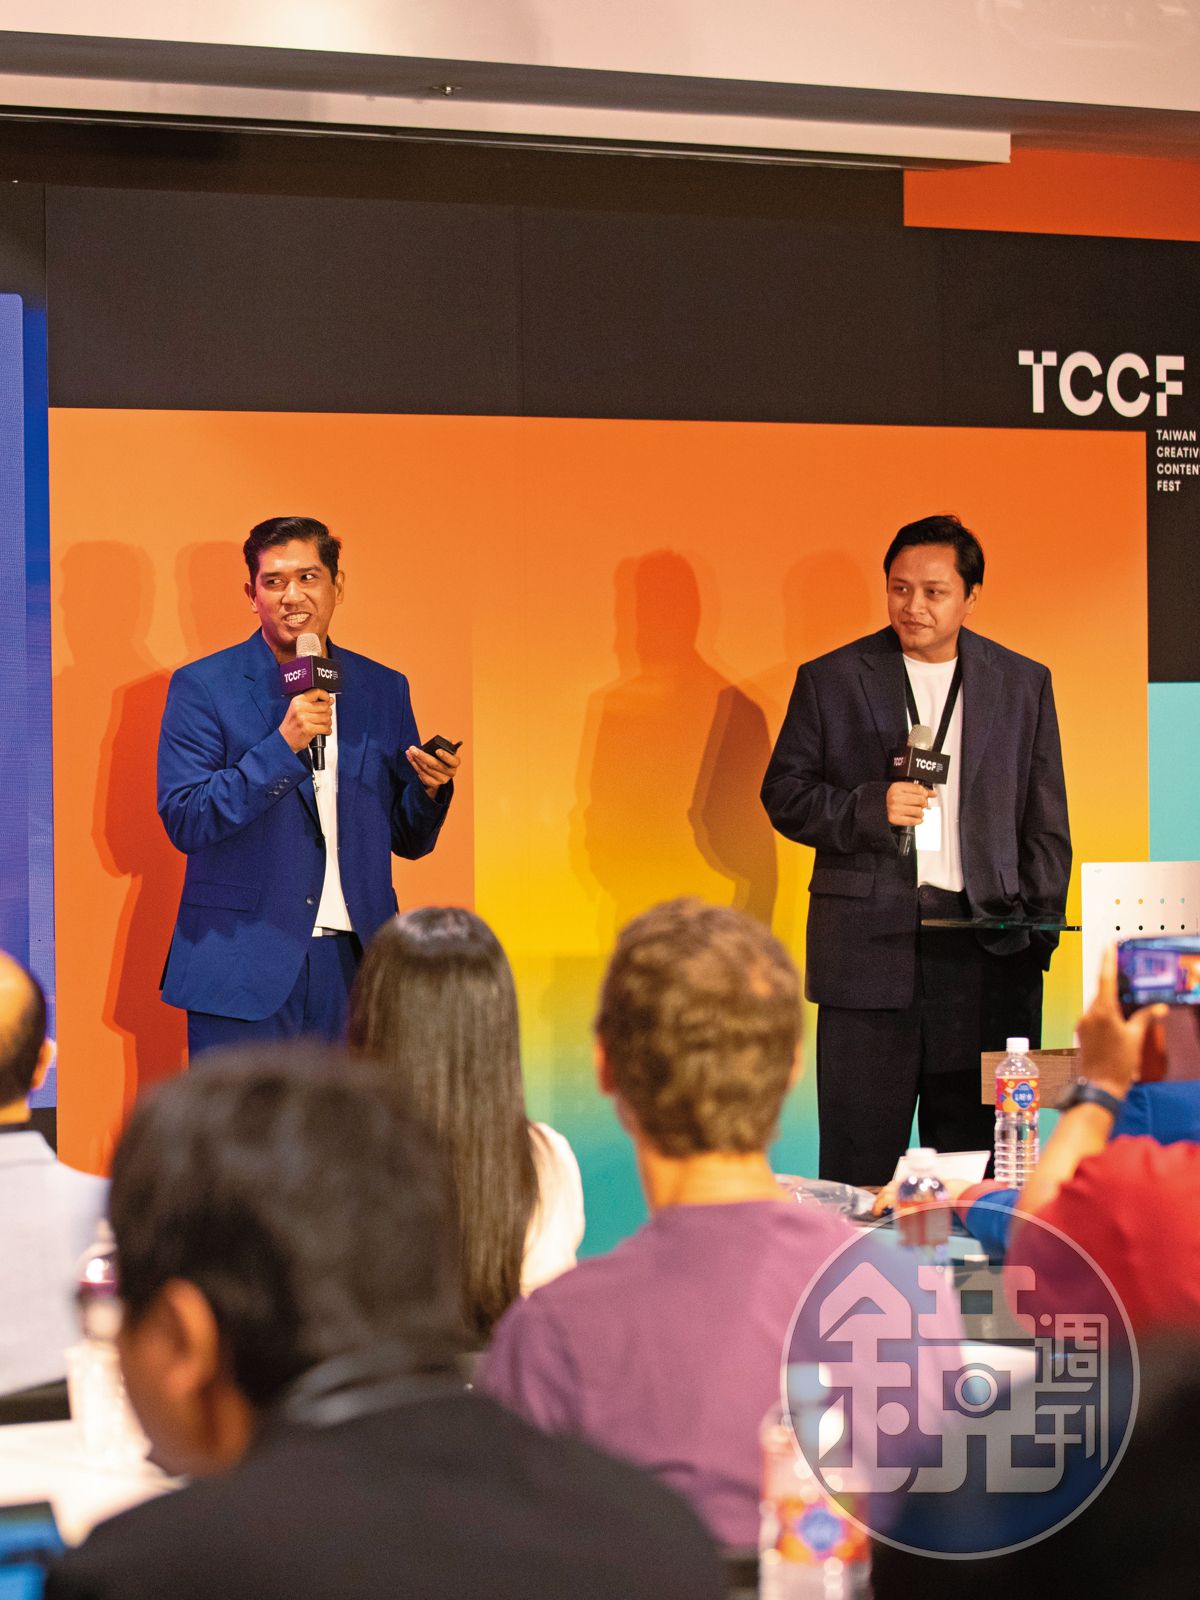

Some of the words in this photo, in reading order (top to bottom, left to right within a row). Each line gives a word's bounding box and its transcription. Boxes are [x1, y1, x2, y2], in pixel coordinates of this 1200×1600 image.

[1018, 350, 1185, 418] TCCF
[1156, 430, 1196, 441] TAIWAN
[1156, 446, 1200, 458] CREATIV
[1157, 463, 1200, 475] CONTEN
[1157, 480, 1181, 491] FEST
[284, 670, 302, 683] TCCF
[316, 667, 333, 679] TCCF
[915, 758, 937, 771] TCCF
